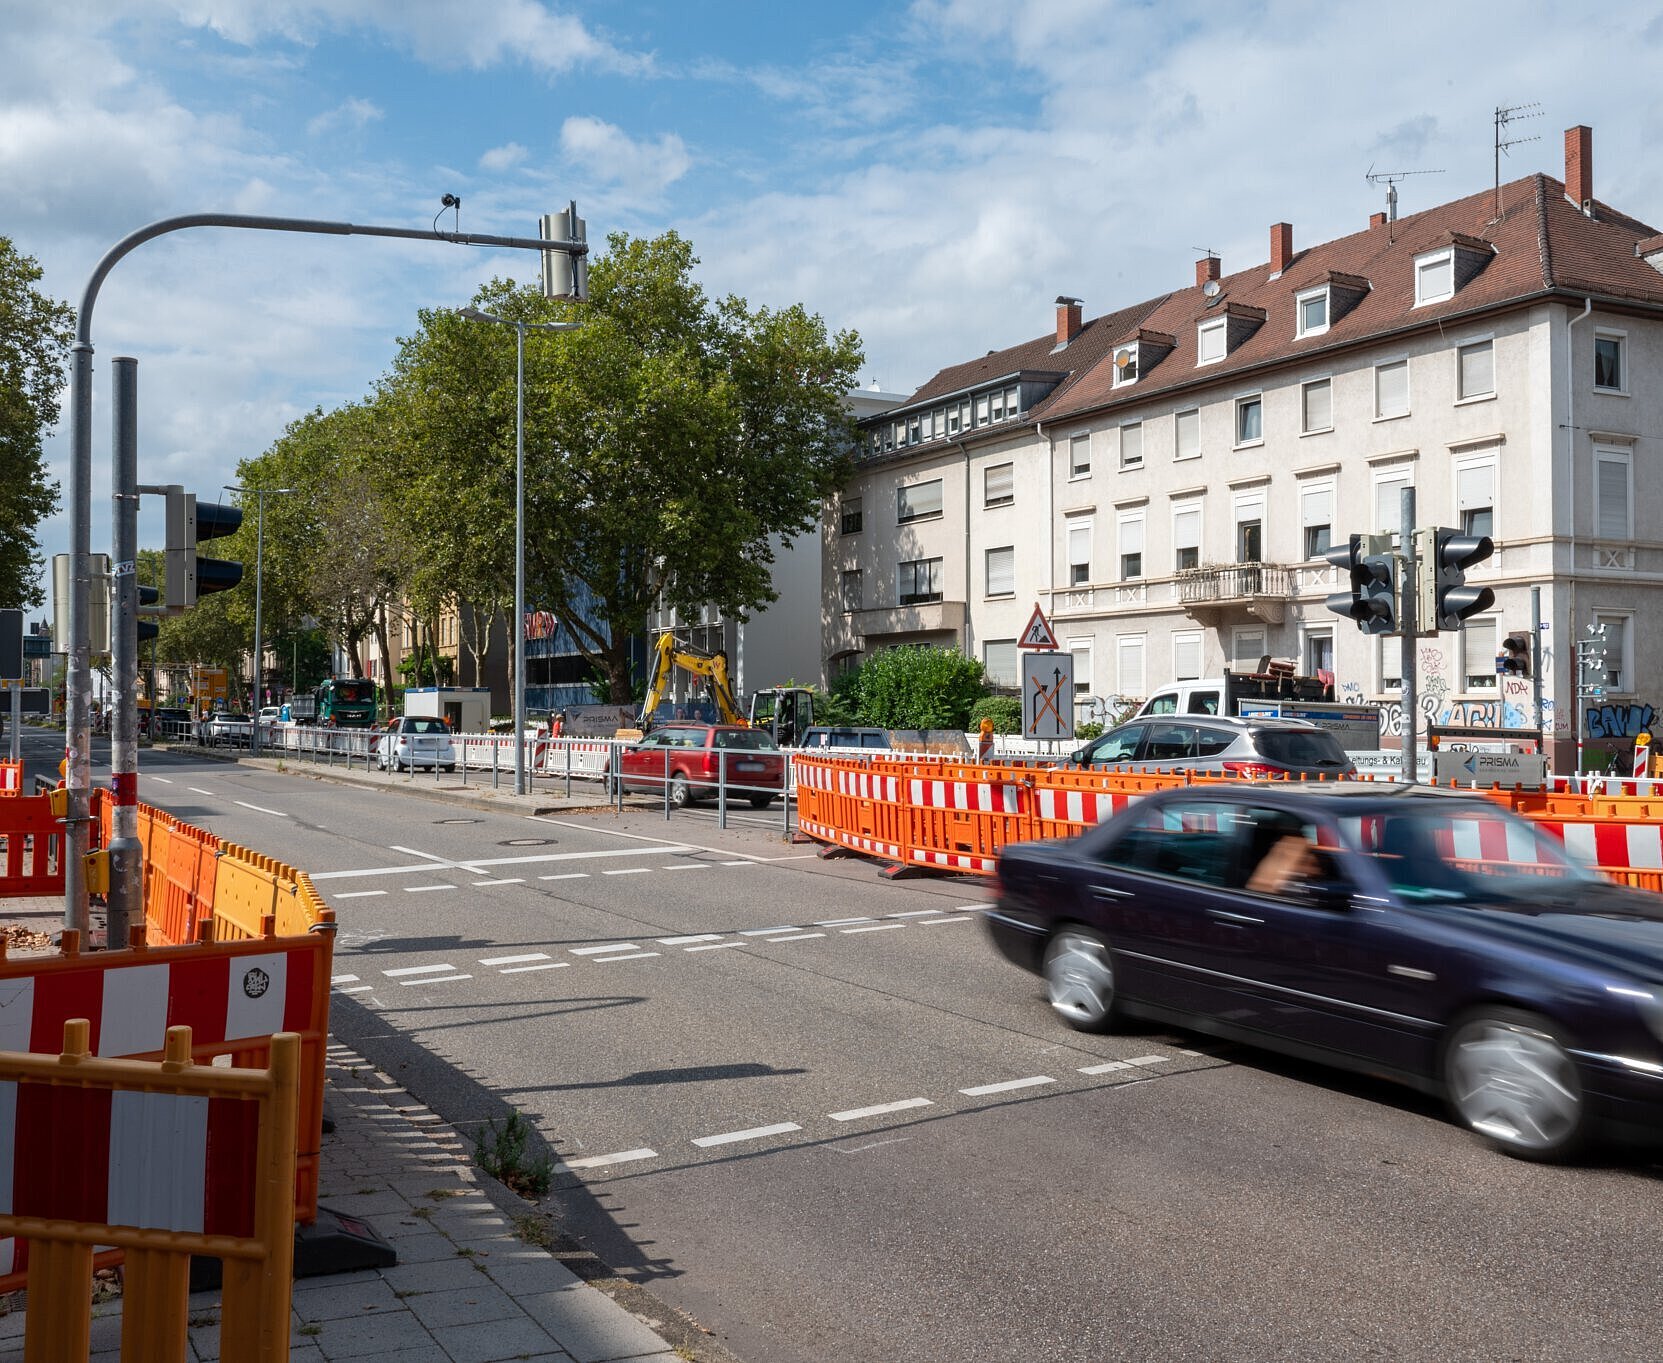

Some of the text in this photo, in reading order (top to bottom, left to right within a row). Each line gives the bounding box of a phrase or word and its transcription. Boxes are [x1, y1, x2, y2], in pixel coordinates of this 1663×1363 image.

[583, 715, 618, 723] PRISMA
[1382, 756, 1388, 765] &
[1479, 757, 1519, 768] PRISMA
